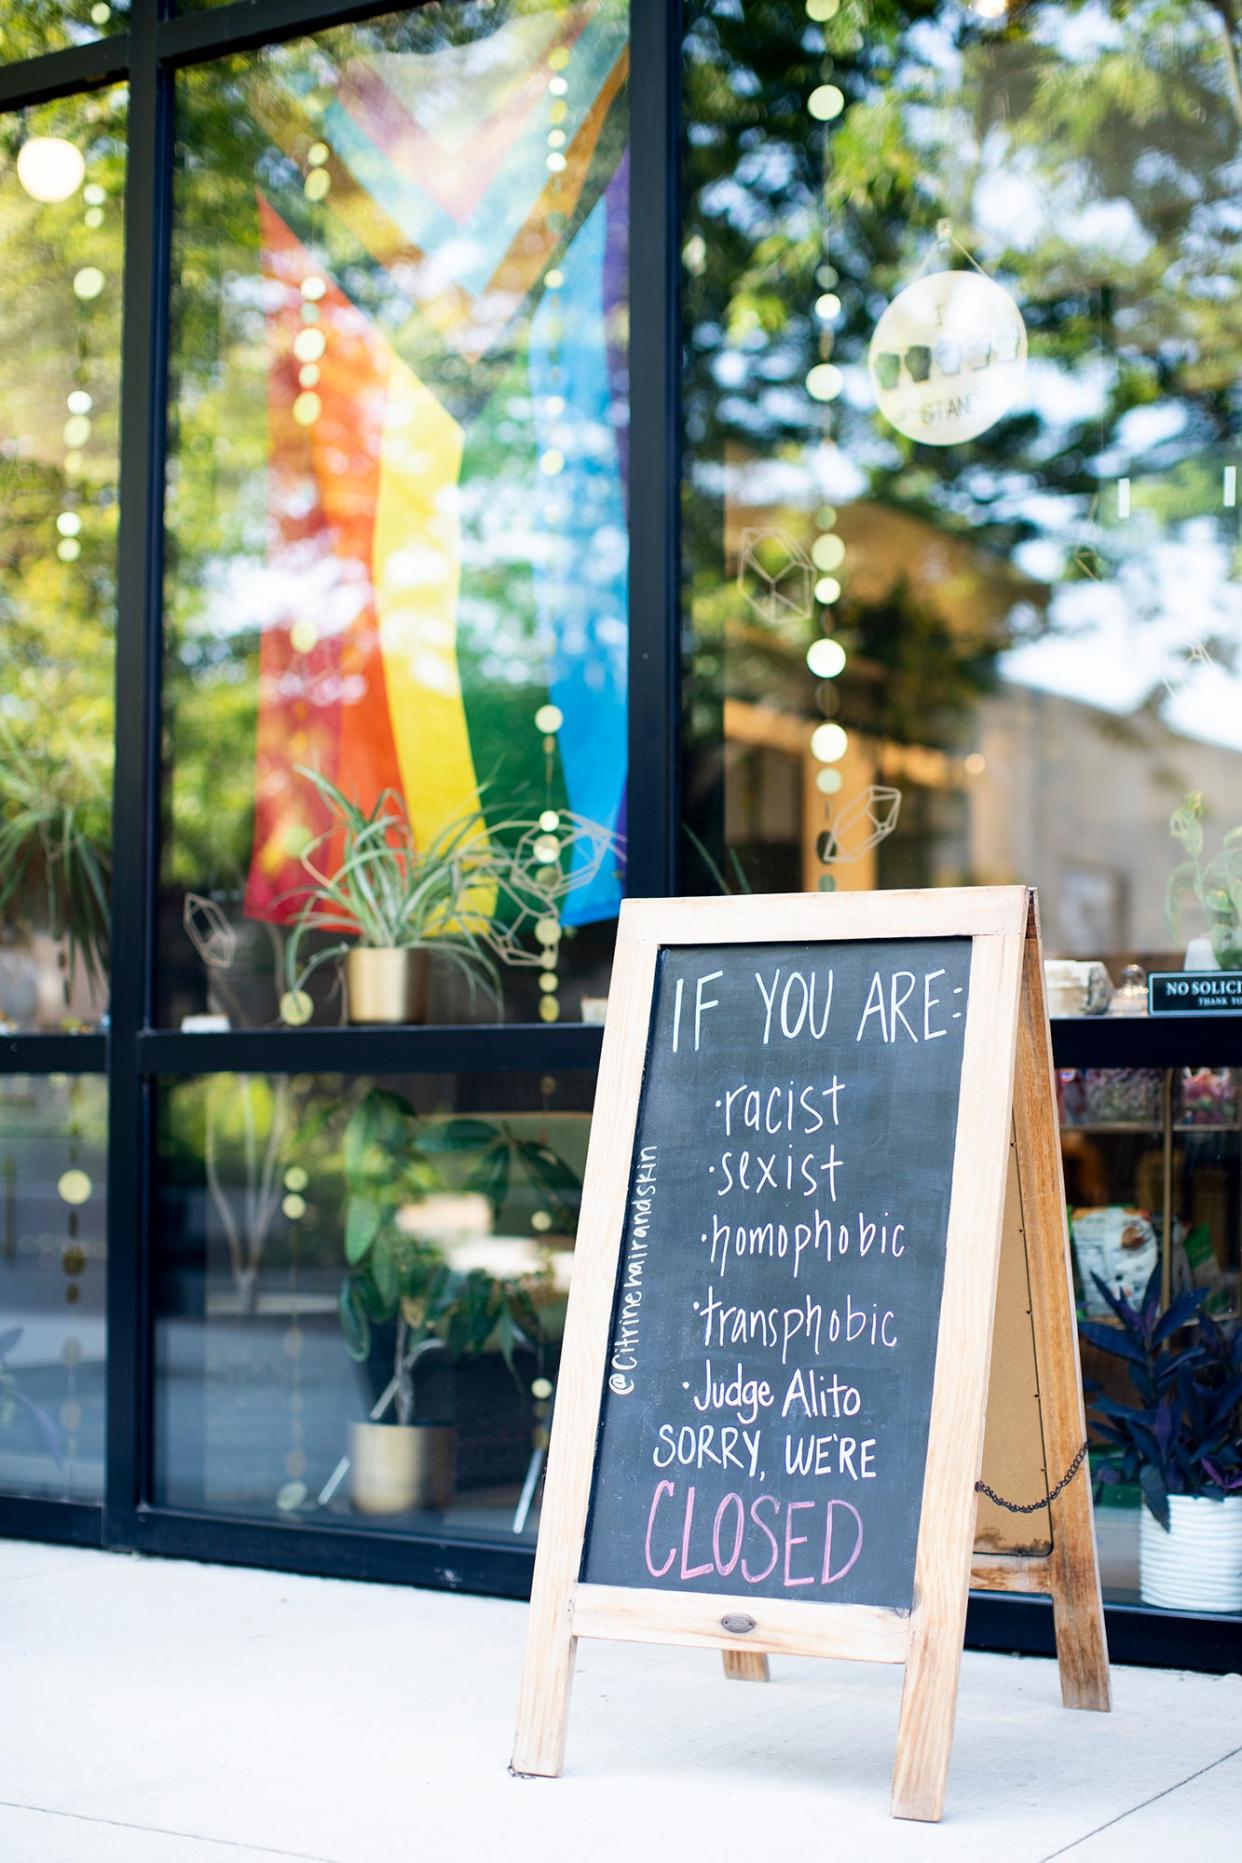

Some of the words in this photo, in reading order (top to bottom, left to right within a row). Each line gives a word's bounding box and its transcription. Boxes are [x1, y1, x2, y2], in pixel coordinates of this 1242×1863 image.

[672, 970, 724, 1053] IF
[755, 968, 834, 1045] YOU
[855, 968, 963, 1044] ARE:
[1166, 981, 1190, 996] NO
[1198, 996, 1229, 1007] THANK
[725, 1075, 846, 1136] racist
[717, 1144, 844, 1202] sexist
[709, 1209, 905, 1278] homophobic
[699, 1285, 898, 1364] transphobic
[693, 1359, 775, 1424] Judge
[781, 1367, 862, 1418] Alito
[652, 1424, 766, 1482] SORRY,
[785, 1433, 877, 1481] WE'RE
[645, 1479, 864, 1587] CLOSED
